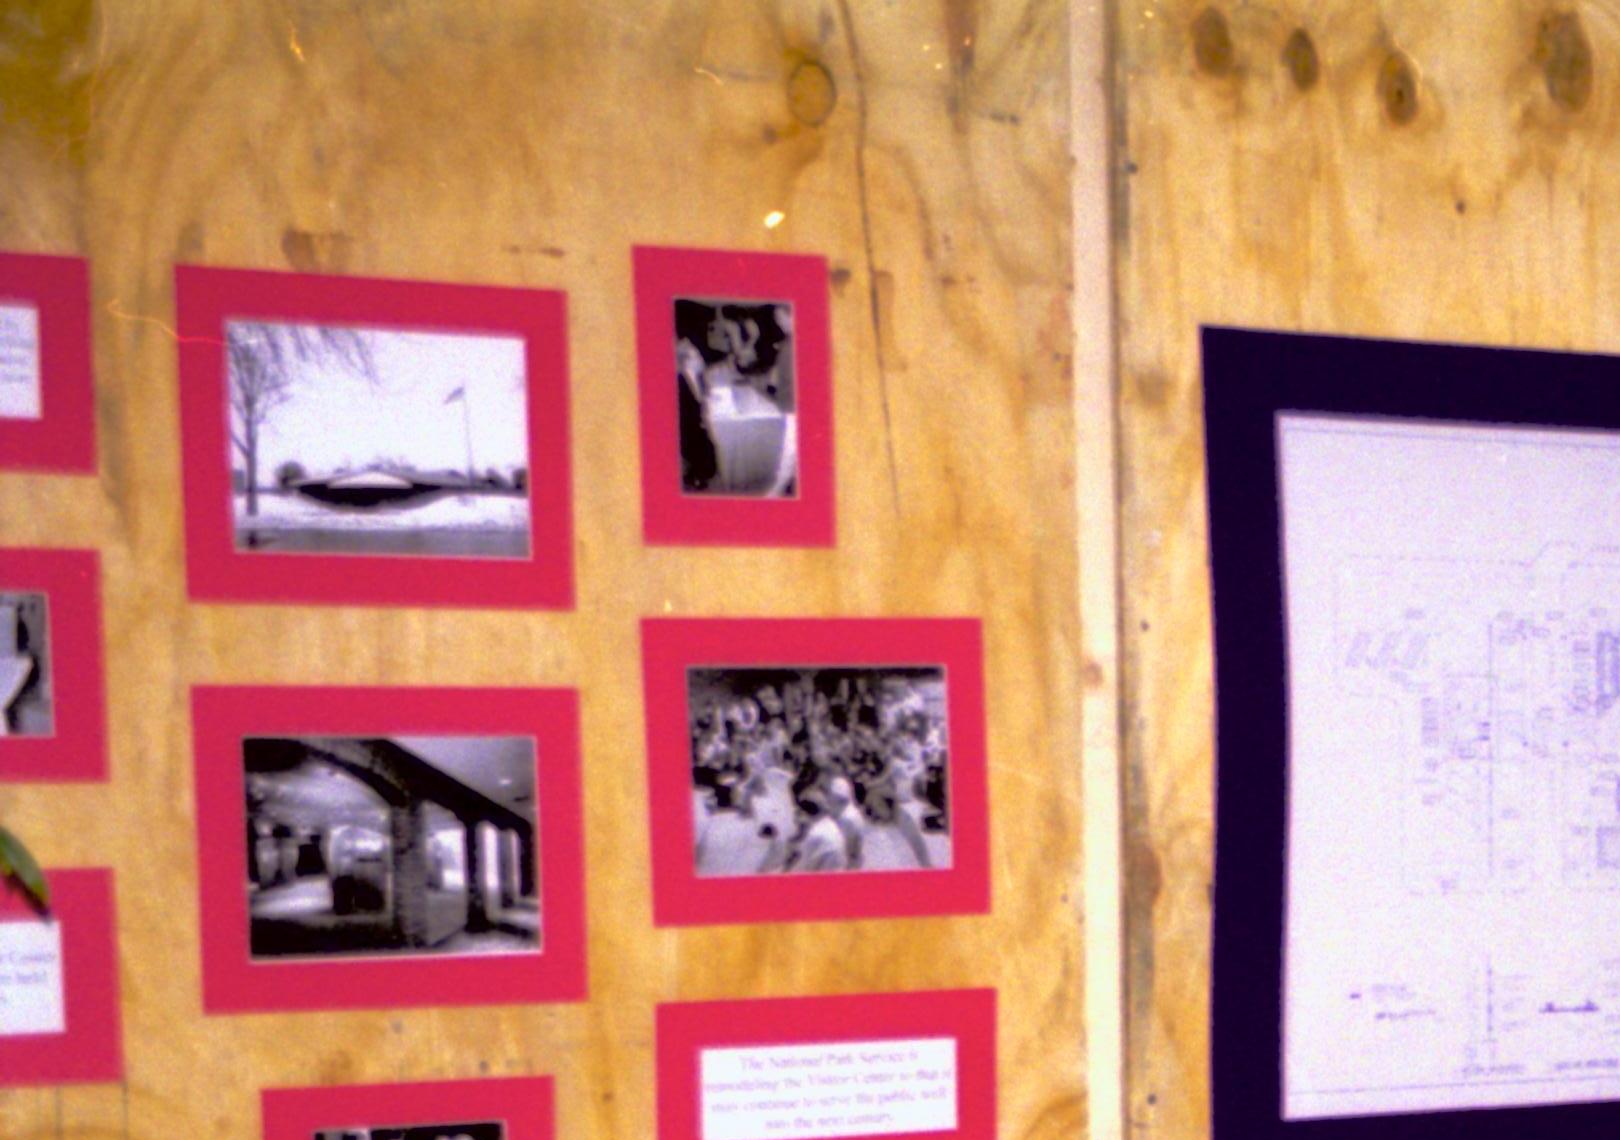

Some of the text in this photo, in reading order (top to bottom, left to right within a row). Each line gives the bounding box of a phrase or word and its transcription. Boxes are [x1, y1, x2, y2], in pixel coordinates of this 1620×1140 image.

[738, 1056, 763, 1071] The
[768, 1053, 822, 1069] National
[826, 1052, 852, 1066] Park
[858, 1050, 904, 1065] Service
[705, 1079, 778, 1095] remodeling
[784, 1077, 802, 1090] the
[807, 1073, 850, 1088] Visitor
[854, 1071, 895, 1085] Center
[916, 1068, 938, 1081] that
[742, 1098, 797, 1112] continue
[855, 1092, 874, 1105] the
[877, 1089, 915, 1106] public
